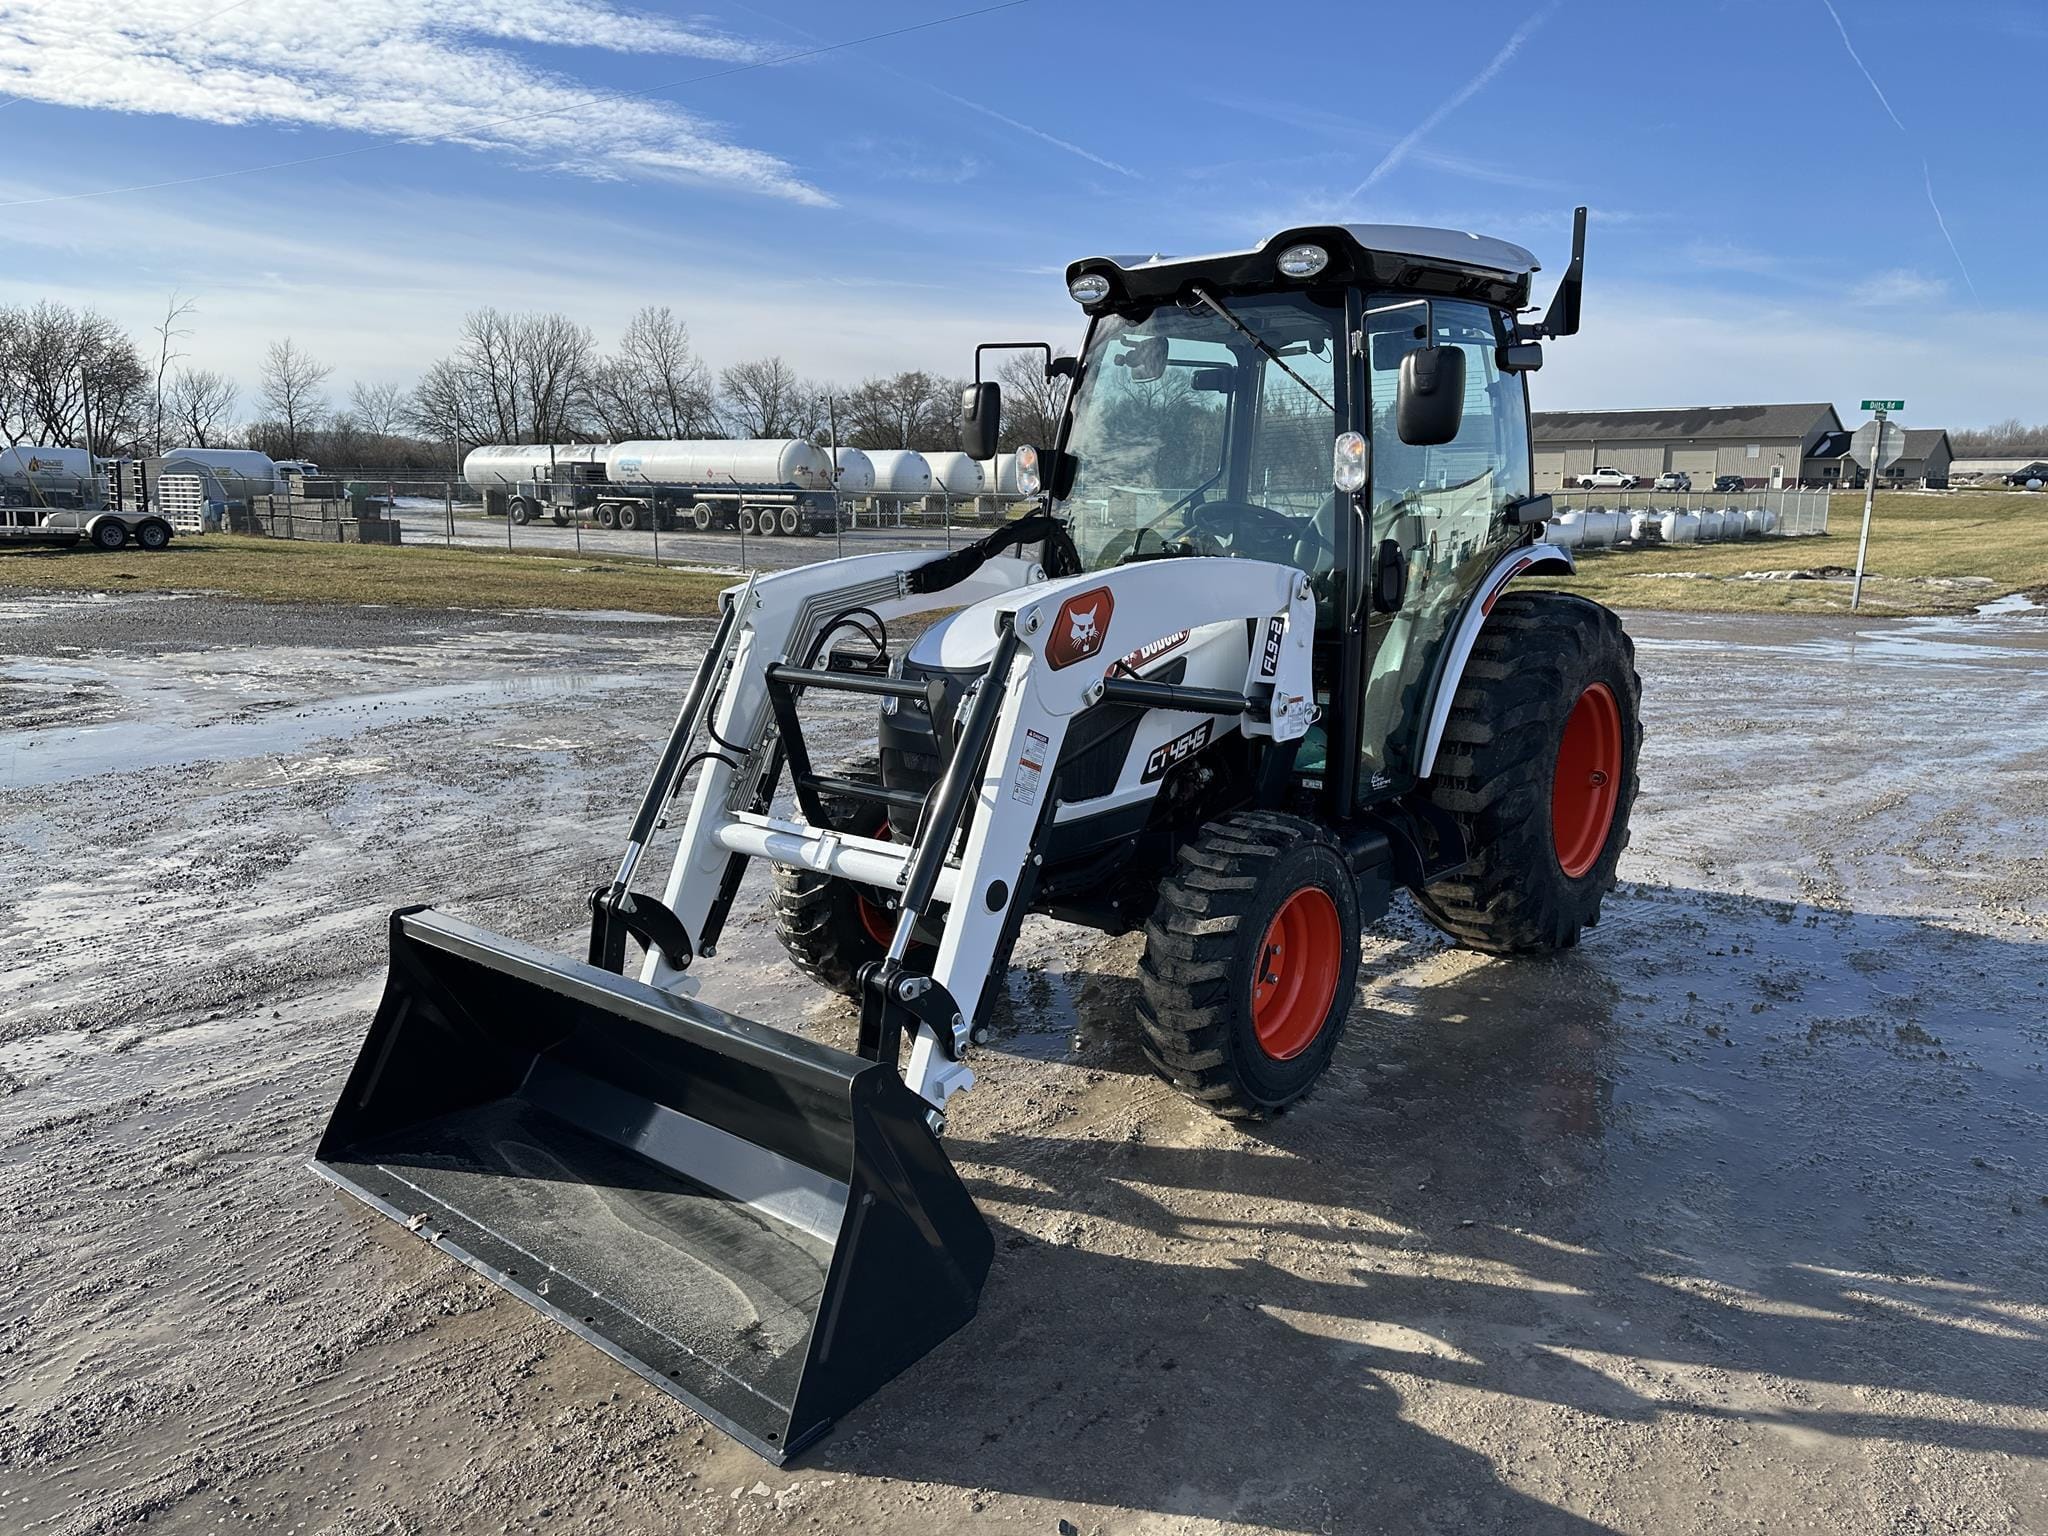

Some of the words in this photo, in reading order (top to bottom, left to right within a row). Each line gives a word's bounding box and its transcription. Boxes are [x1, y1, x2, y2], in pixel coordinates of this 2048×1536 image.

[1886, 401, 1896, 409] Rd
[1263, 619, 1283, 674] FL9-2
[1147, 725, 1207, 774] CT4545
